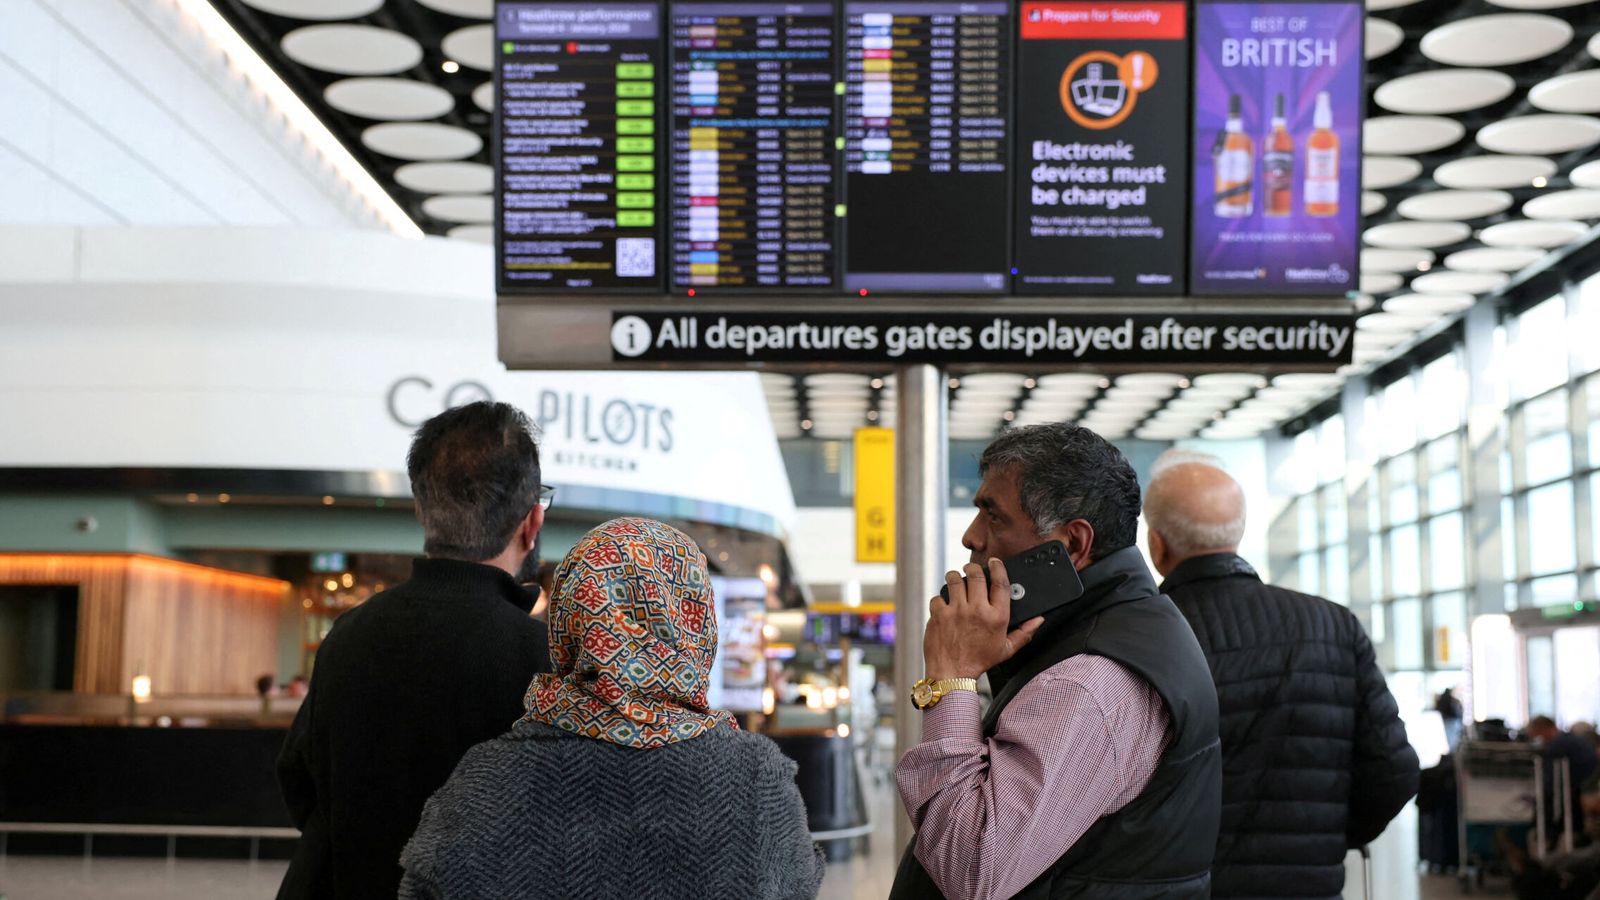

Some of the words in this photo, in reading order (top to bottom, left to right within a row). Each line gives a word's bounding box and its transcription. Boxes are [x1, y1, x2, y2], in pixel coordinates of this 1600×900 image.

[517, 9, 576, 21] Heathrow
[577, 9, 652, 22] performance
[1042, 9, 1089, 24] Prepare
[1090, 9, 1109, 22] for
[1111, 9, 1161, 24] Security
[1251, 16, 1285, 32] BEST
[1287, 16, 1309, 32] OF
[1222, 38, 1338, 67] BRITISH
[1032, 140, 1134, 161] Electronic
[1031, 162, 1110, 183] devices
[1112, 164, 1167, 183] must
[1031, 184, 1060, 205] be
[1061, 184, 1147, 209] charged
[656, 317, 698, 349] All
[704, 317, 879, 356] departures
[885, 322, 973, 357] gates
[979, 318, 1133, 358] displayed
[1140, 318, 1217, 350] after
[1222, 319, 1350, 358] security
[538, 389, 674, 453] PILOTS
